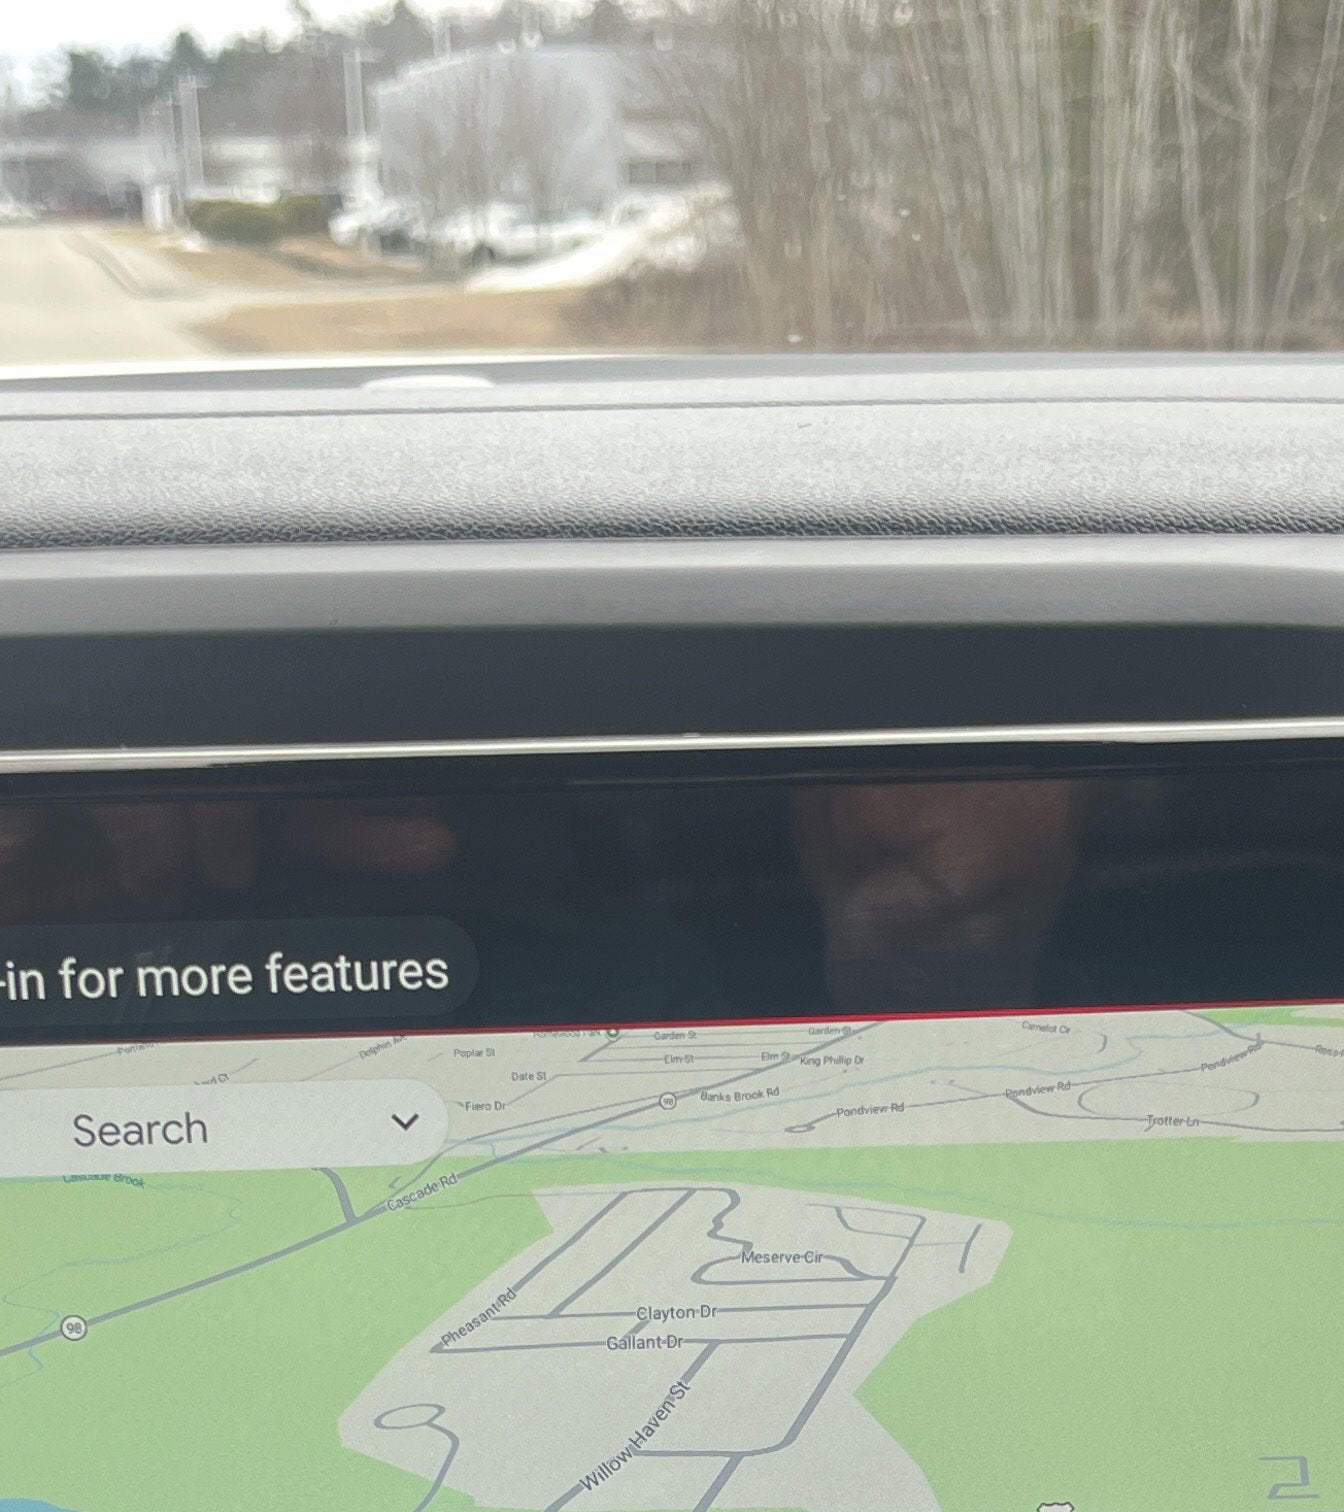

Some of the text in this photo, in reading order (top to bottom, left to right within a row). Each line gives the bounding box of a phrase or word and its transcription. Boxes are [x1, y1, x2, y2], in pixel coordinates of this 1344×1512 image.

[58, 956, 124, 999] for
[138, 961, 253, 998] more
[265, 951, 449, 993] features
[800, 1056, 821, 1067] King
[766, 1086, 780, 1098] Rd
[1005, 1080, 1071, 1099] Pondview Rd
[837, 1102, 905, 1118] Pondview Rd
[73, 1112, 208, 1147] Search
[1147, 1115, 1184, 1127] Trotter
[387, 1172, 458, 1212] Cascade Rd
[741, 1250, 824, 1264] Meserve Cir
[441, 1287, 517, 1347] Pheasant Rd
[636, 1304, 718, 1323] Clayton Dr
[67, 1322, 82, 1335] 98
[607, 1334, 684, 1351] Gallant Dr
[579, 1380, 690, 1491] Willow Haven St
